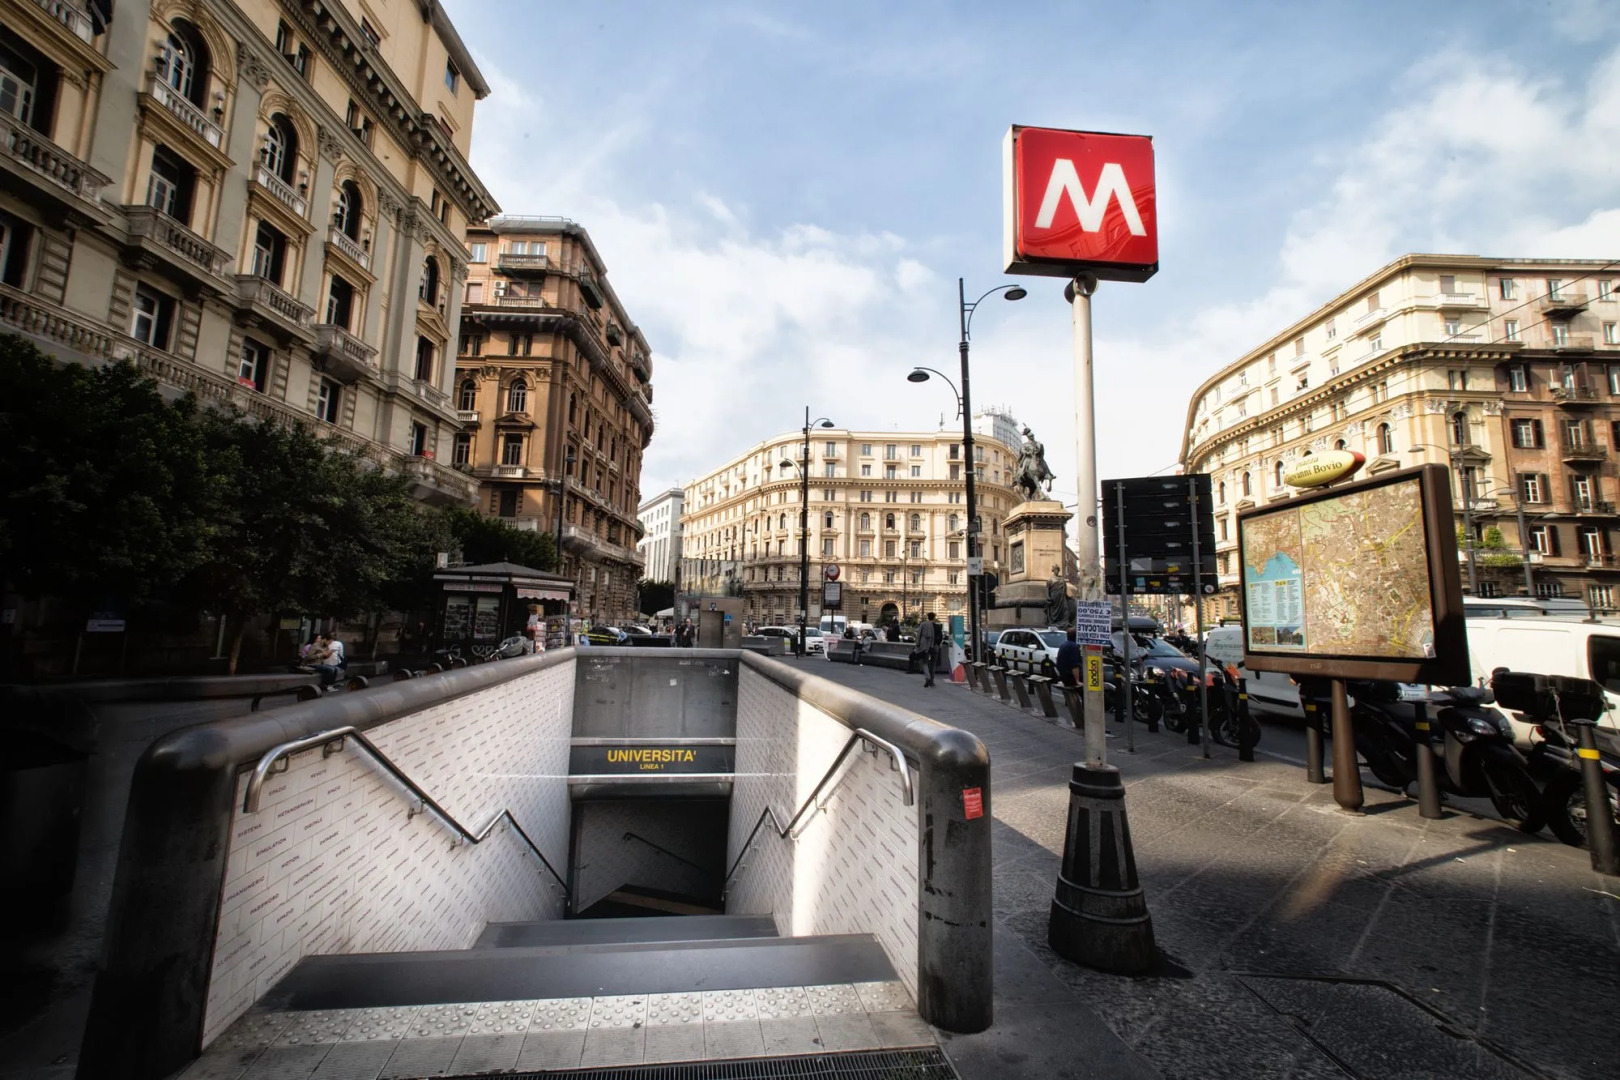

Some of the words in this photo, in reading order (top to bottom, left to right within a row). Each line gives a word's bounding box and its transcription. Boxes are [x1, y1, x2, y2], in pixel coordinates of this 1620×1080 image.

[1034, 158, 1147, 237] M
[1078, 624, 1110, 633] TRILOCALE
[608, 749, 697, 762] UNIVERSITA'
[269, 785, 287, 796] SPAZIO
[256, 837, 287, 857] SIMULATION
[250, 893, 280, 914] PASSWORD
